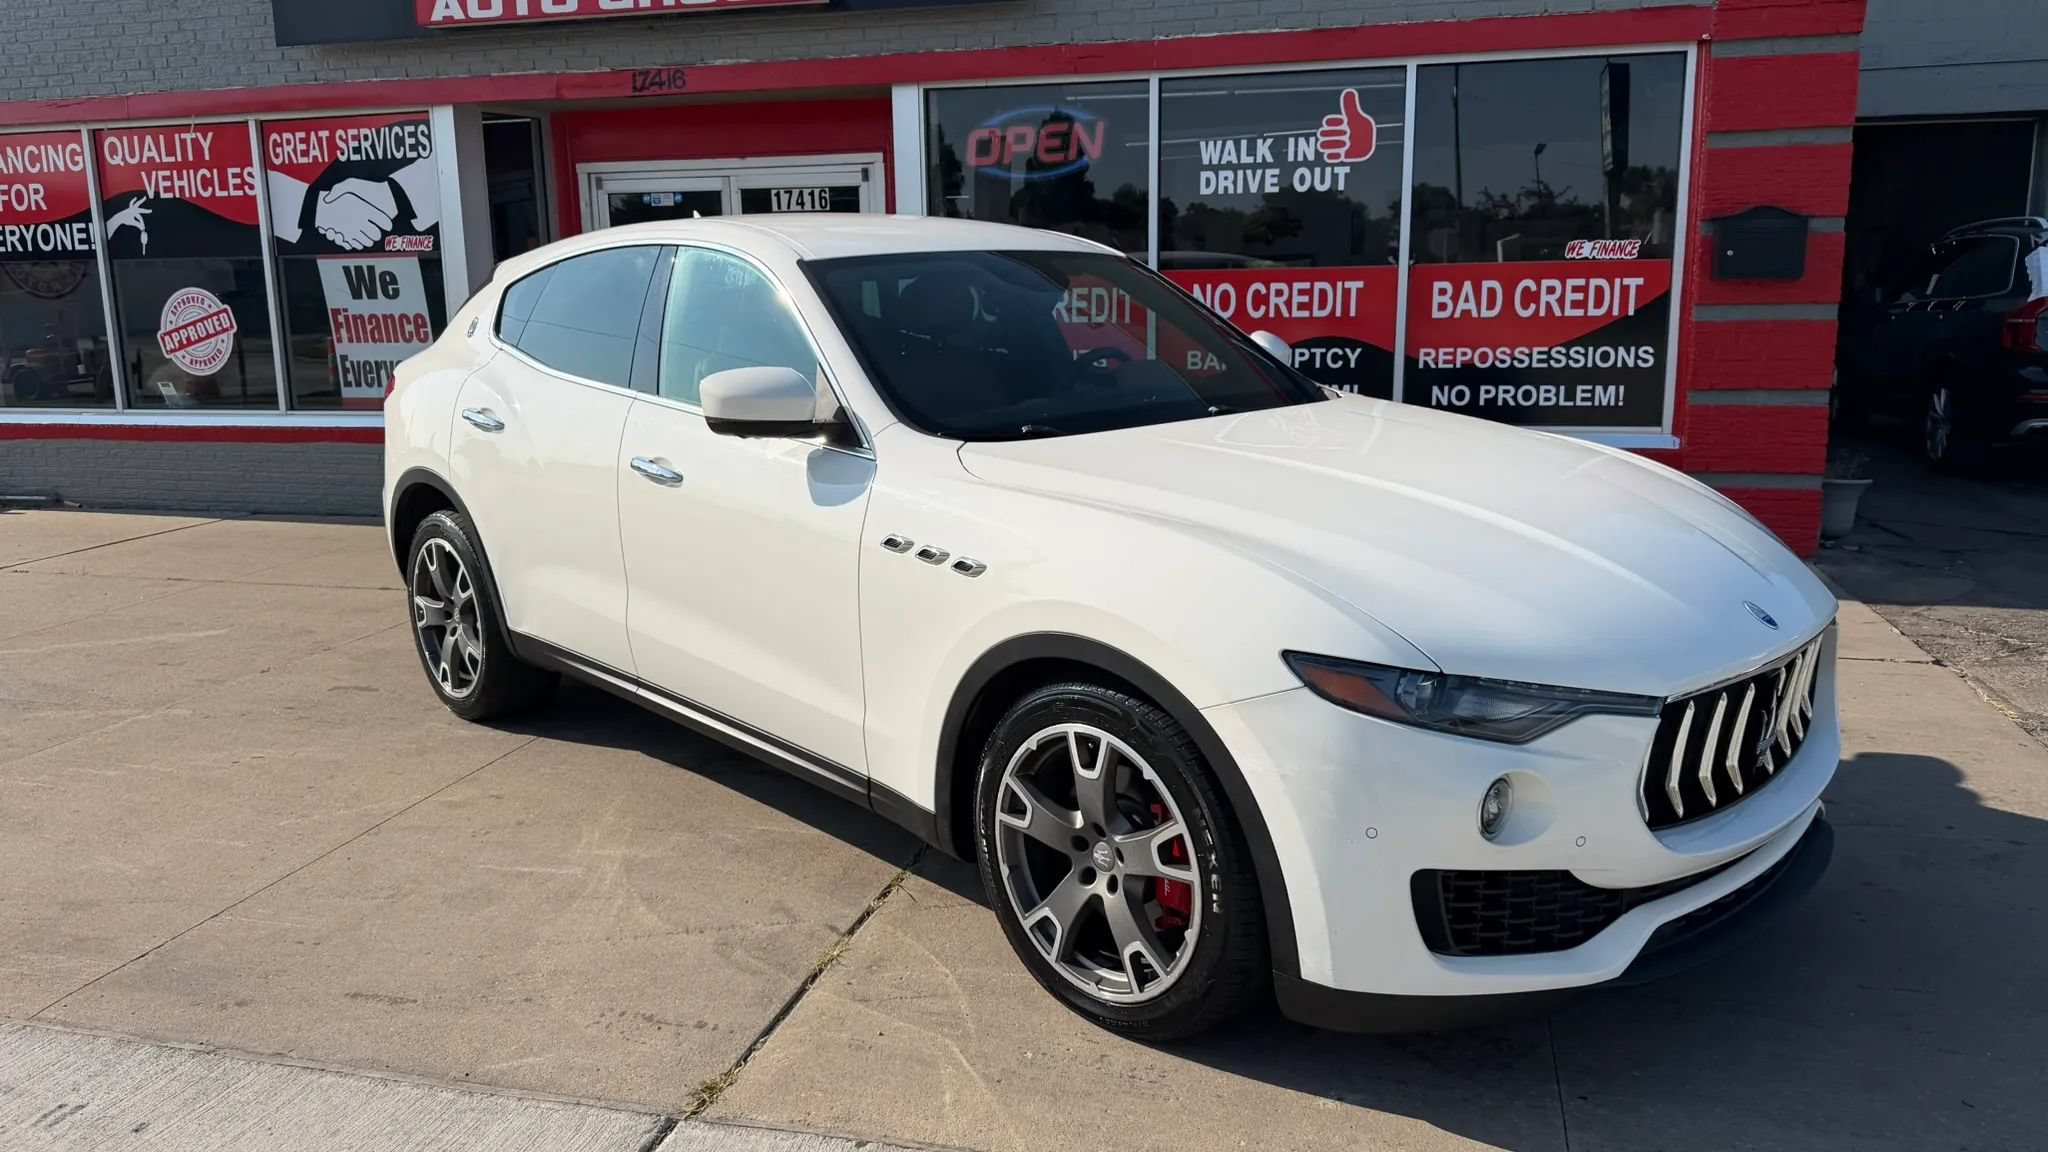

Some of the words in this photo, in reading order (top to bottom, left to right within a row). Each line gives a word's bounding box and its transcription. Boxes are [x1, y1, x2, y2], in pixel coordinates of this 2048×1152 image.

[631, 69, 687, 93] 17416
[103, 132, 214, 167] QUALITY
[269, 130, 330, 165] GREAT
[335, 124, 430, 162] SERVICES
[966, 120, 1106, 167] OPEN
[1200, 138, 1274, 165] WALK
[1287, 136, 1316, 162] IN
[140, 166, 258, 199] VEHICLES
[1200, 168, 1280, 195] DRIVE
[1293, 166, 1351, 192] OUT
[0, 183, 47, 212] FOR
[773, 188, 829, 210] 17416
[385, 236, 398, 249] WE
[400, 235, 433, 249] FINANCE
[1566, 240, 1587, 257] WE
[1589, 239, 1641, 258] FINANCE
[342, 265, 400, 300] We
[170, 295, 206, 317] APPROVED
[1192, 282, 1236, 319] NO
[1246, 280, 1364, 319] CREDIT
[1431, 279, 1503, 319] BAD
[1514, 277, 1644, 317] CREDIT
[163, 312, 231, 352] APPROVED
[330, 308, 430, 344] Finance
[189, 348, 223, 368] APPROVED
[1418, 346, 1655, 369] REPOSSESSIONS
[1431, 385, 1471, 407] NO
[1479, 384, 1625, 406] PROBLEM!
